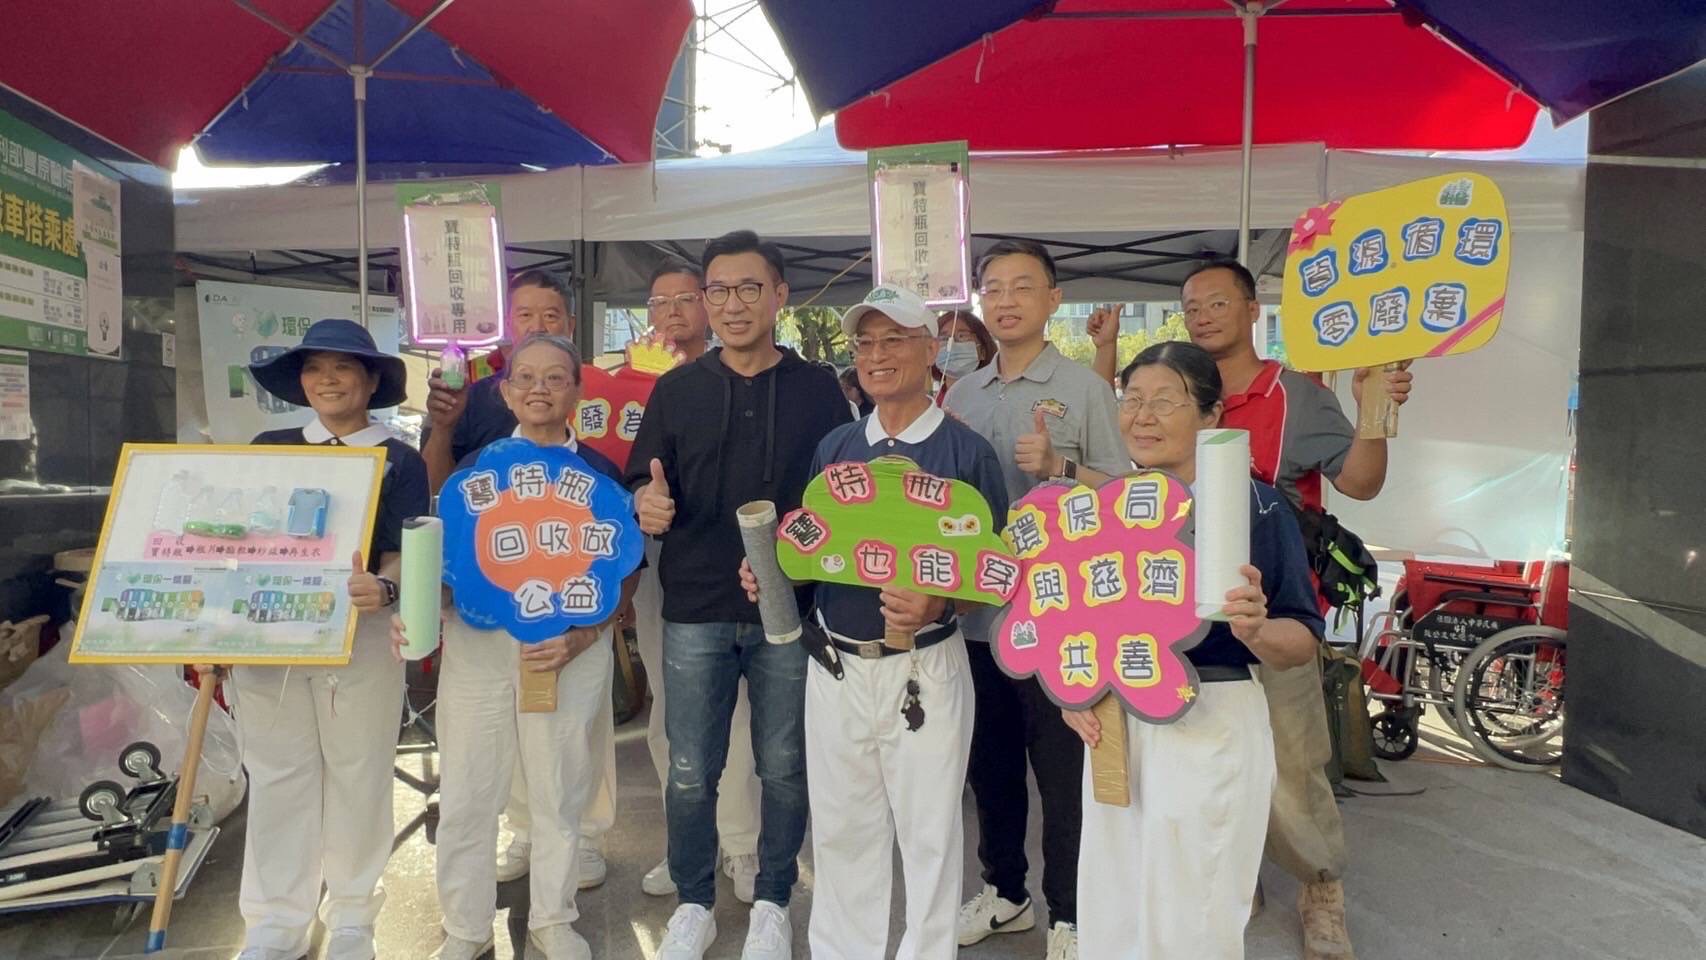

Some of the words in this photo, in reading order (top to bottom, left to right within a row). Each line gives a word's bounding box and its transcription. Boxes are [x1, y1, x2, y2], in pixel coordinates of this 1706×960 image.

[0, 190, 79, 257] 車搭乘處
[1303, 220, 1497, 289] 資源循環
[466, 466, 592, 505] 寶特瓶
[785, 465, 945, 547] 寶特瓶
[495, 523, 612, 559] 回收做
[1008, 481, 1158, 555] 環保局
[860, 544, 1015, 594] 也能穿
[1033, 557, 1178, 608] 與慈濟
[520, 579, 595, 614] 公益
[1063, 640, 1154, 680] 共善
